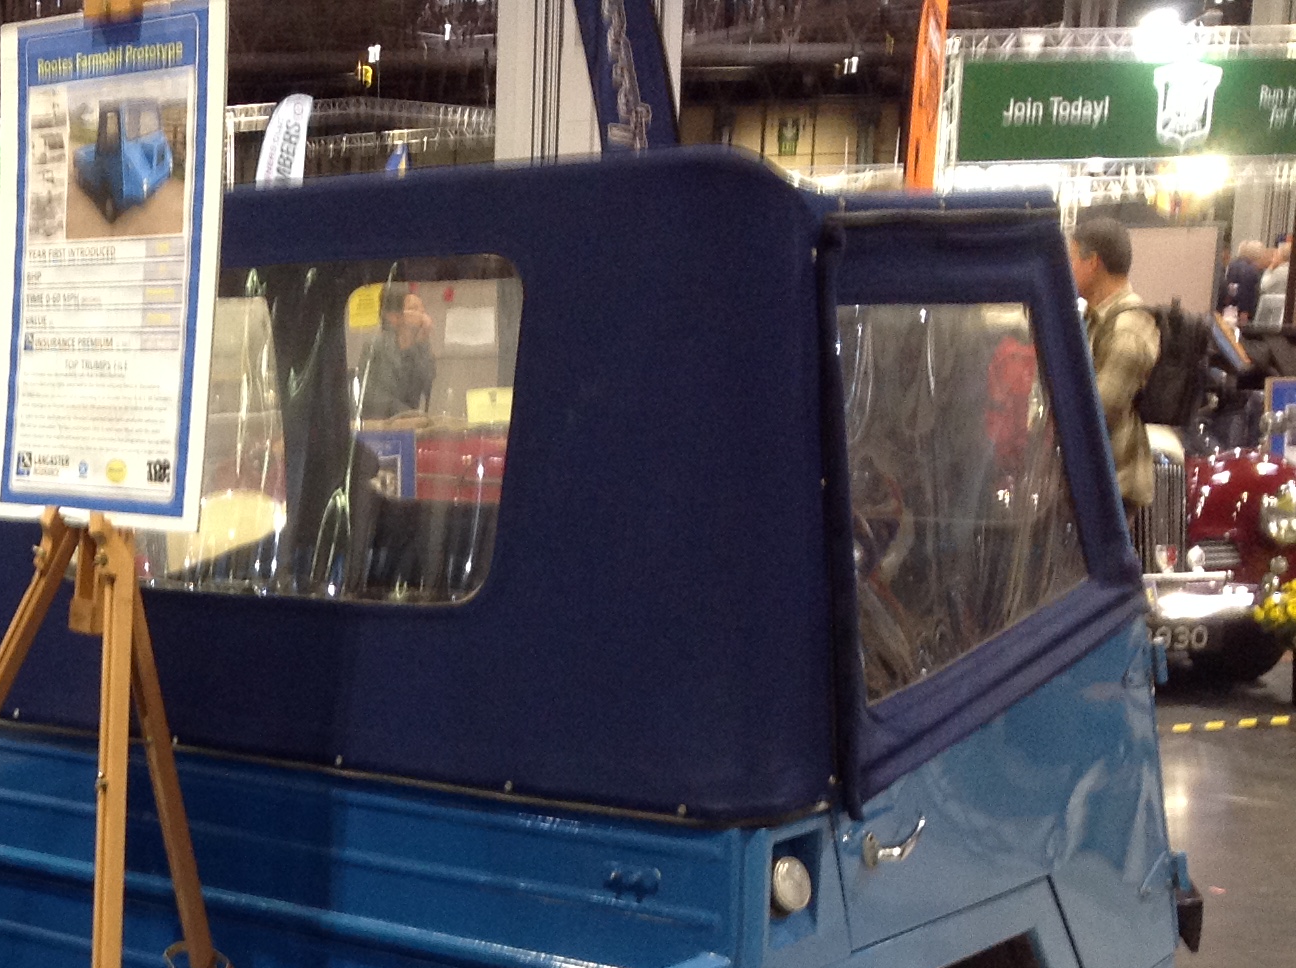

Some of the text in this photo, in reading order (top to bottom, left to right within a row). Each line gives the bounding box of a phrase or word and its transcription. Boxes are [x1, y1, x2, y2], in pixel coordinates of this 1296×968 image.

[75, 47, 123, 73] Farmobil
[125, 41, 183, 66] Prototype
[1003, 95, 1110, 127] Join Today!
[28, 249, 47, 260] YEAR
[67, 245, 116, 260] INTRODUCED
[34, 337, 76, 348] INSURANCE
[77, 336, 114, 348] PREMIUM
